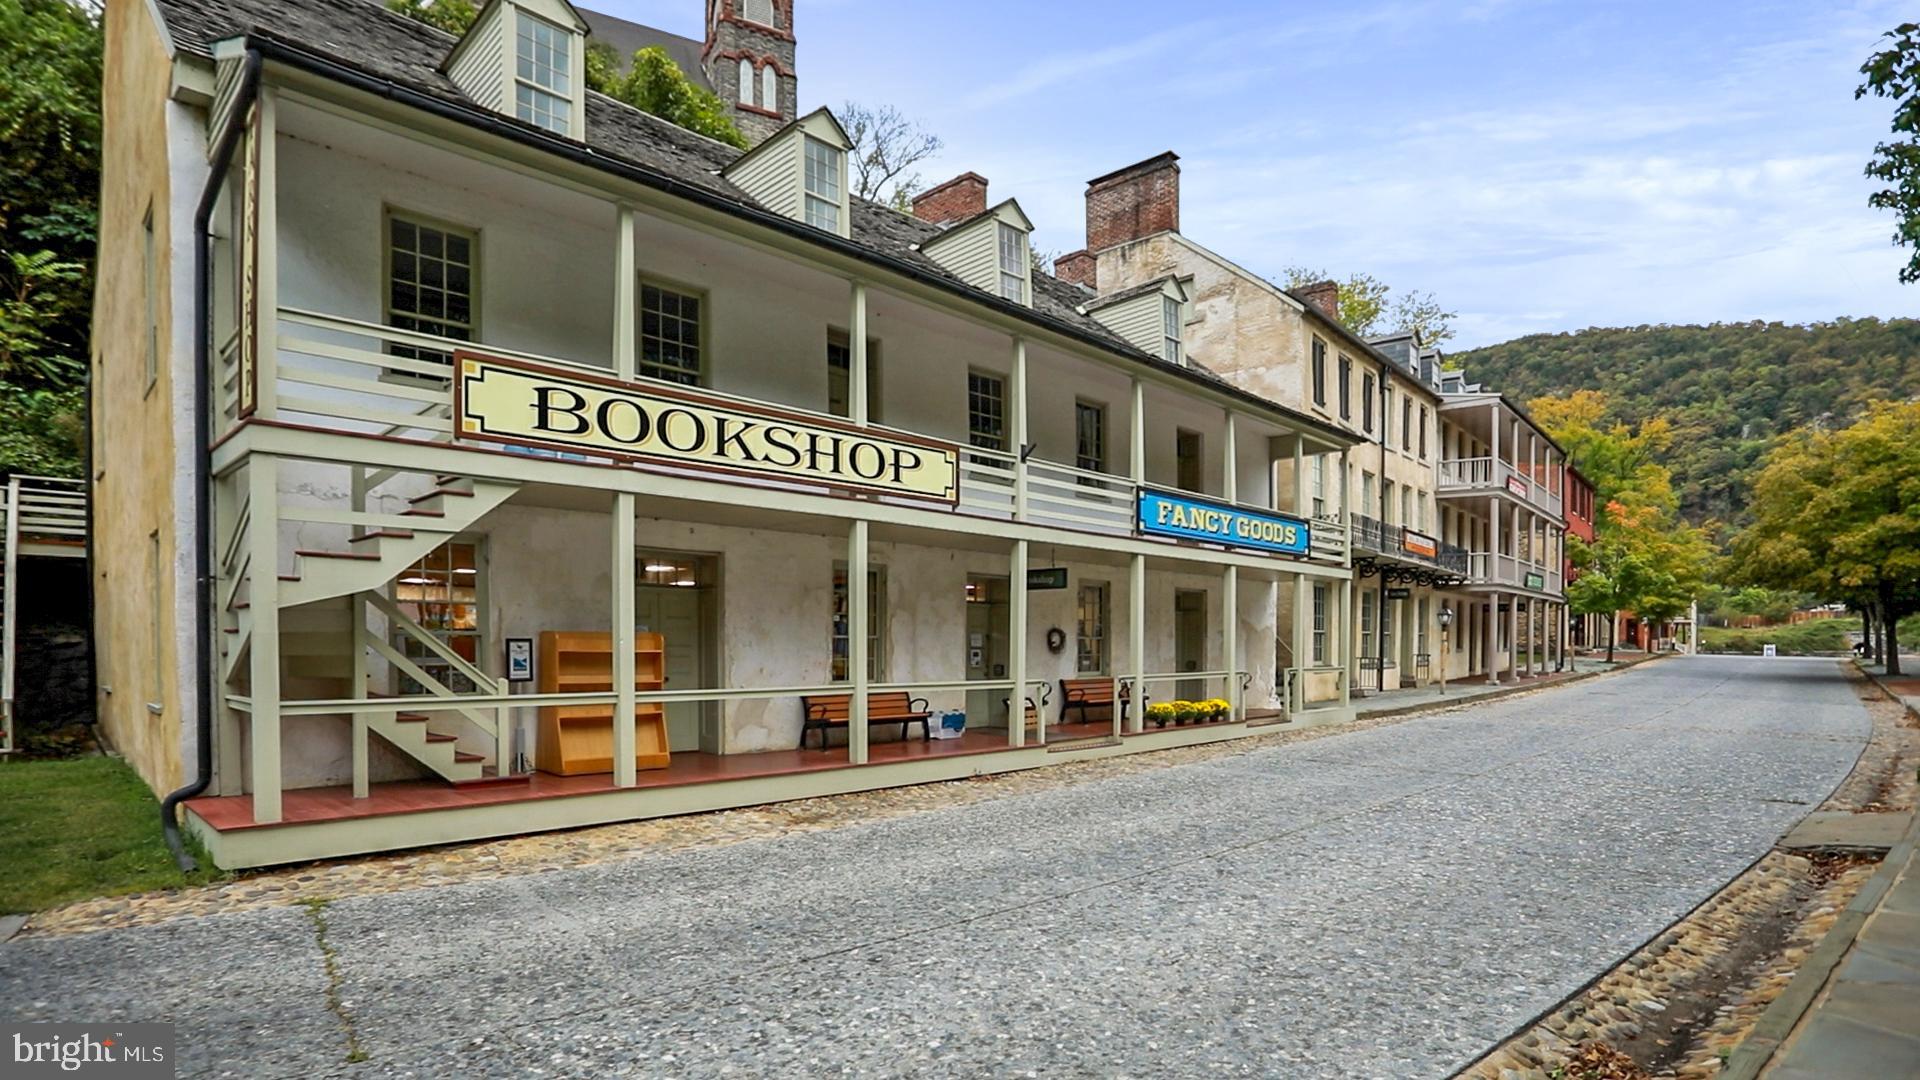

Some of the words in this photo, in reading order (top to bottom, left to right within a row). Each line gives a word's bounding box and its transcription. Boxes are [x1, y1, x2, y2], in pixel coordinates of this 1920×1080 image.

[530, 387, 922, 483] BOOKSHOP
[1158, 501, 1233, 534] FANCY
[1238, 518, 1296, 545] GOODS
